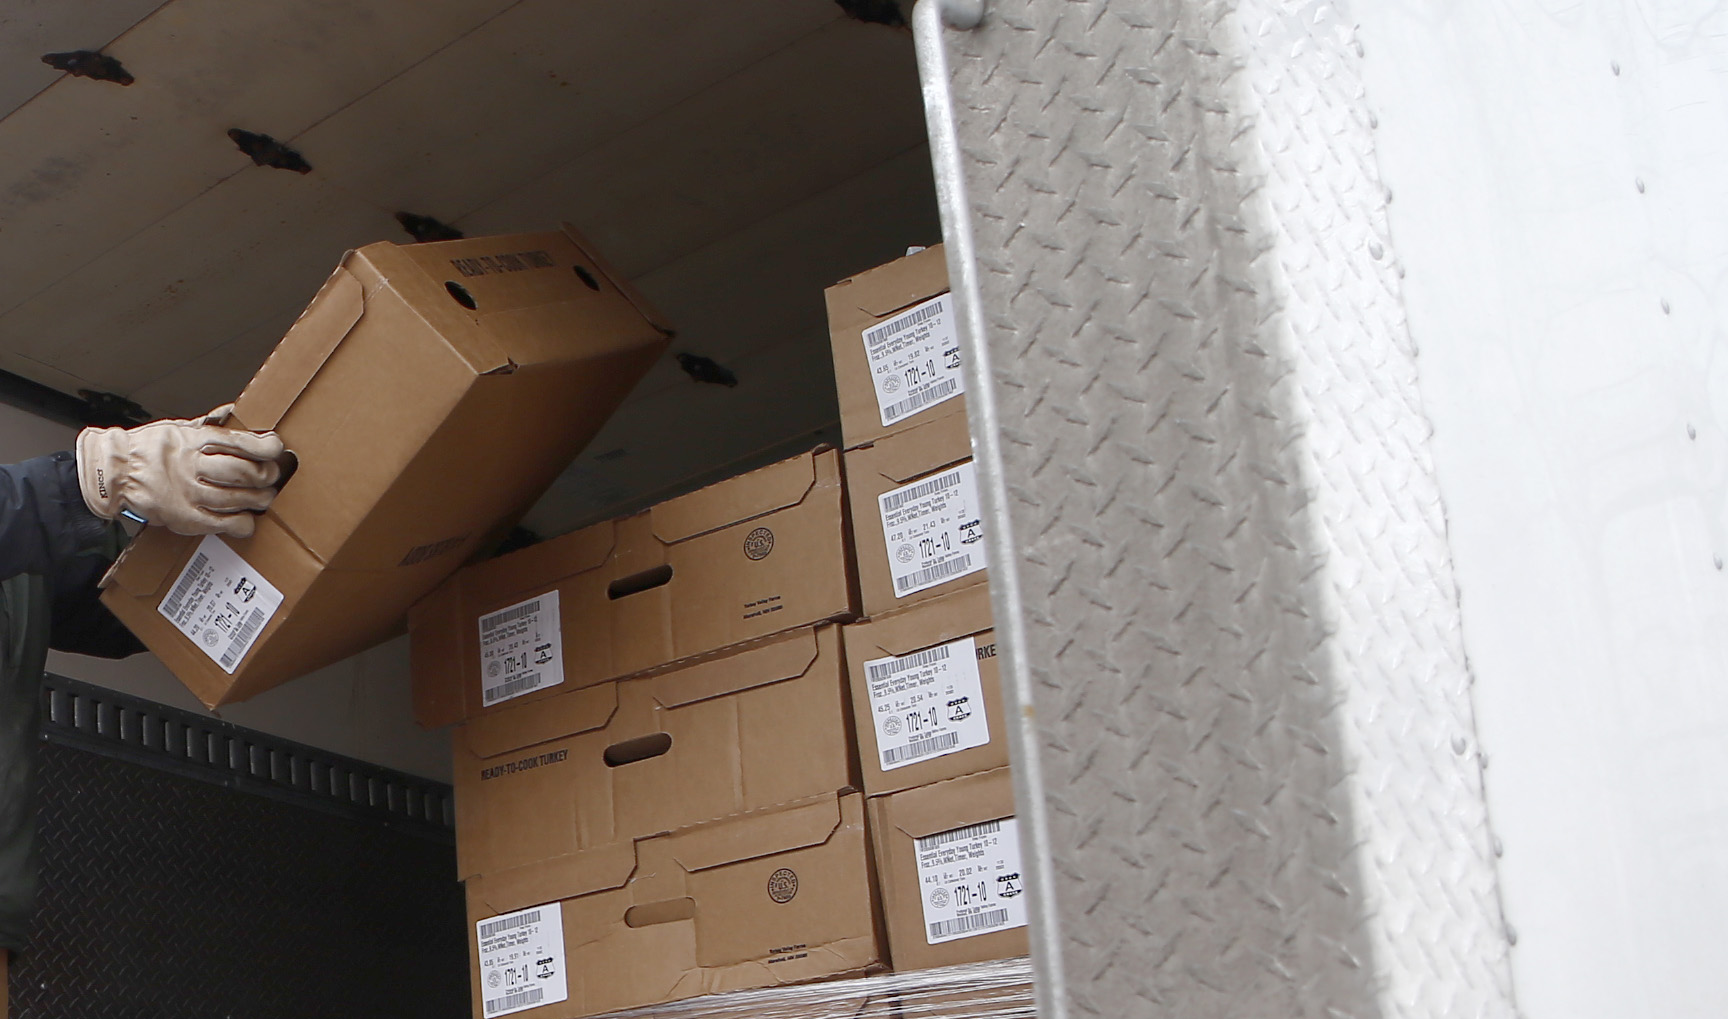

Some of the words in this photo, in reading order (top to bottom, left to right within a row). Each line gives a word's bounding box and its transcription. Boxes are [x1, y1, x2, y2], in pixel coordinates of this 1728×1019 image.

[951, 352, 959, 362] A
[903, 358, 936, 388] 1721-10
[967, 527, 975, 537] A
[918, 530, 950, 559] 1721-10
[242, 587, 250, 595] A
[976, 644, 997, 660] RKE
[954, 704, 963, 715] A
[905, 706, 938, 732] 1721-10
[481, 756, 539, 780] READY-TO-COOK
[539, 749, 569, 766] TURKEY
[1004, 880, 1013, 890] A
[953, 881, 987, 906] 1721-10
[542, 964, 548, 972] A
